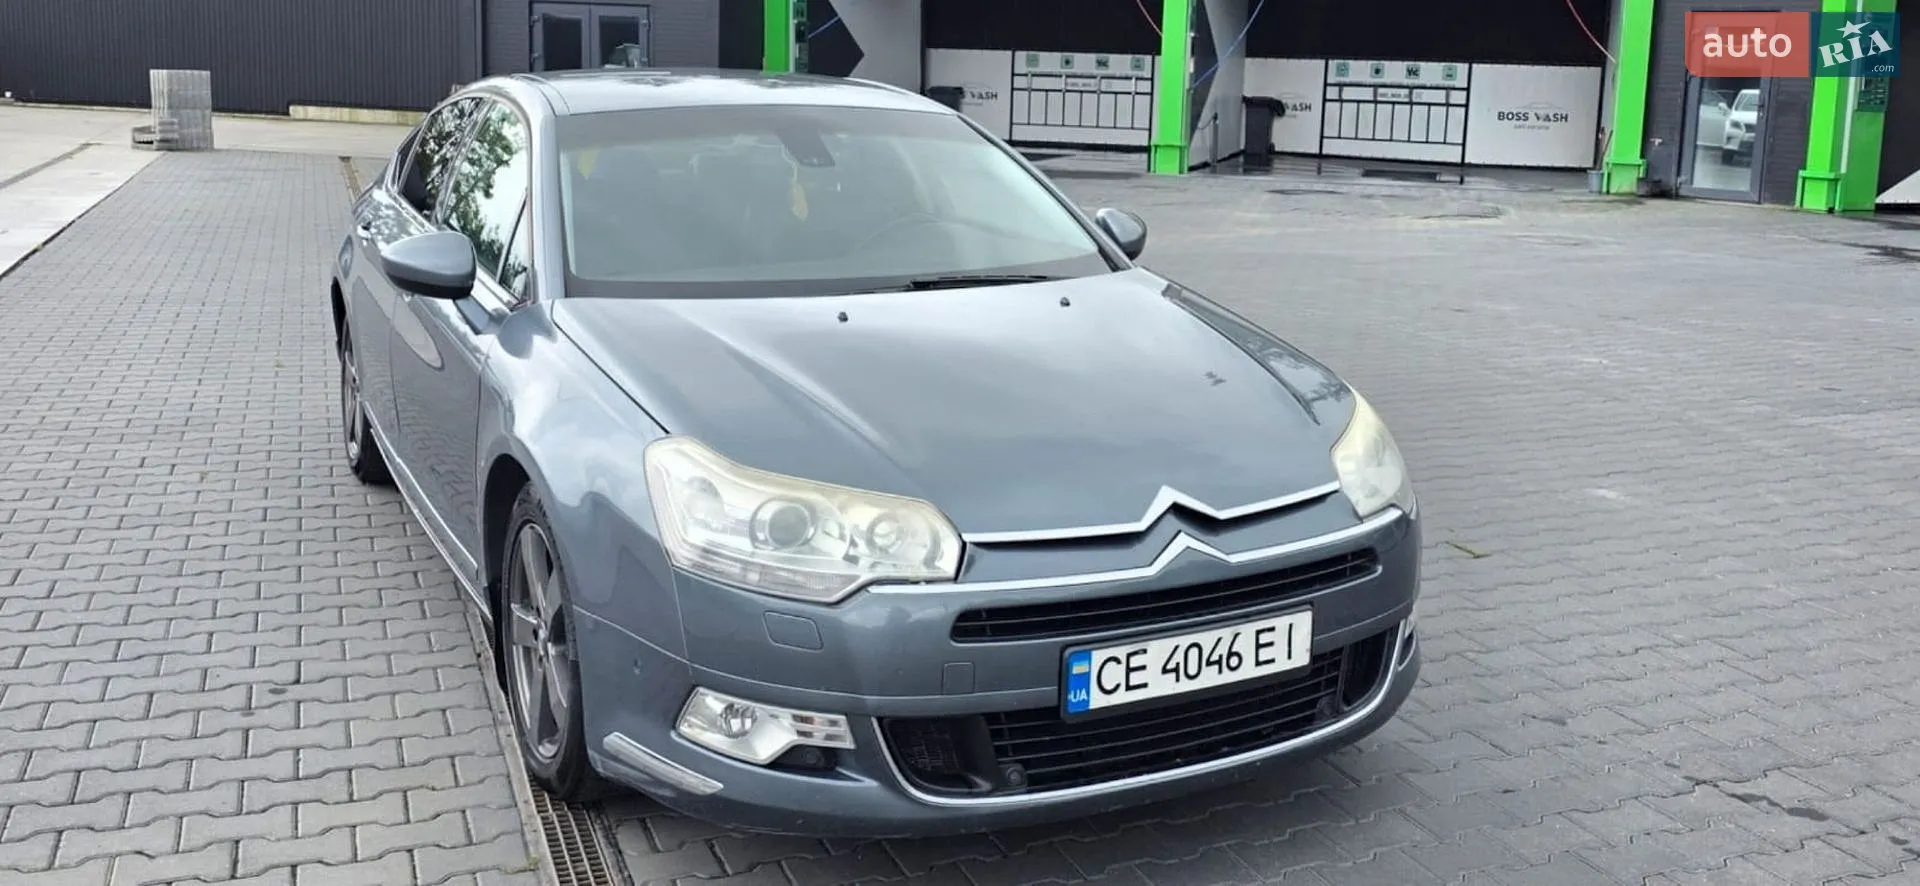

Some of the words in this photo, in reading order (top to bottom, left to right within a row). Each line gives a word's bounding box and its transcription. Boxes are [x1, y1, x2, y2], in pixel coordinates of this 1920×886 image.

[1497, 111, 1529, 121] BOSS
[1096, 648, 1148, 695] CE
[1161, 632, 1243, 683] 4046
[1070, 688, 1088, 702] UA
